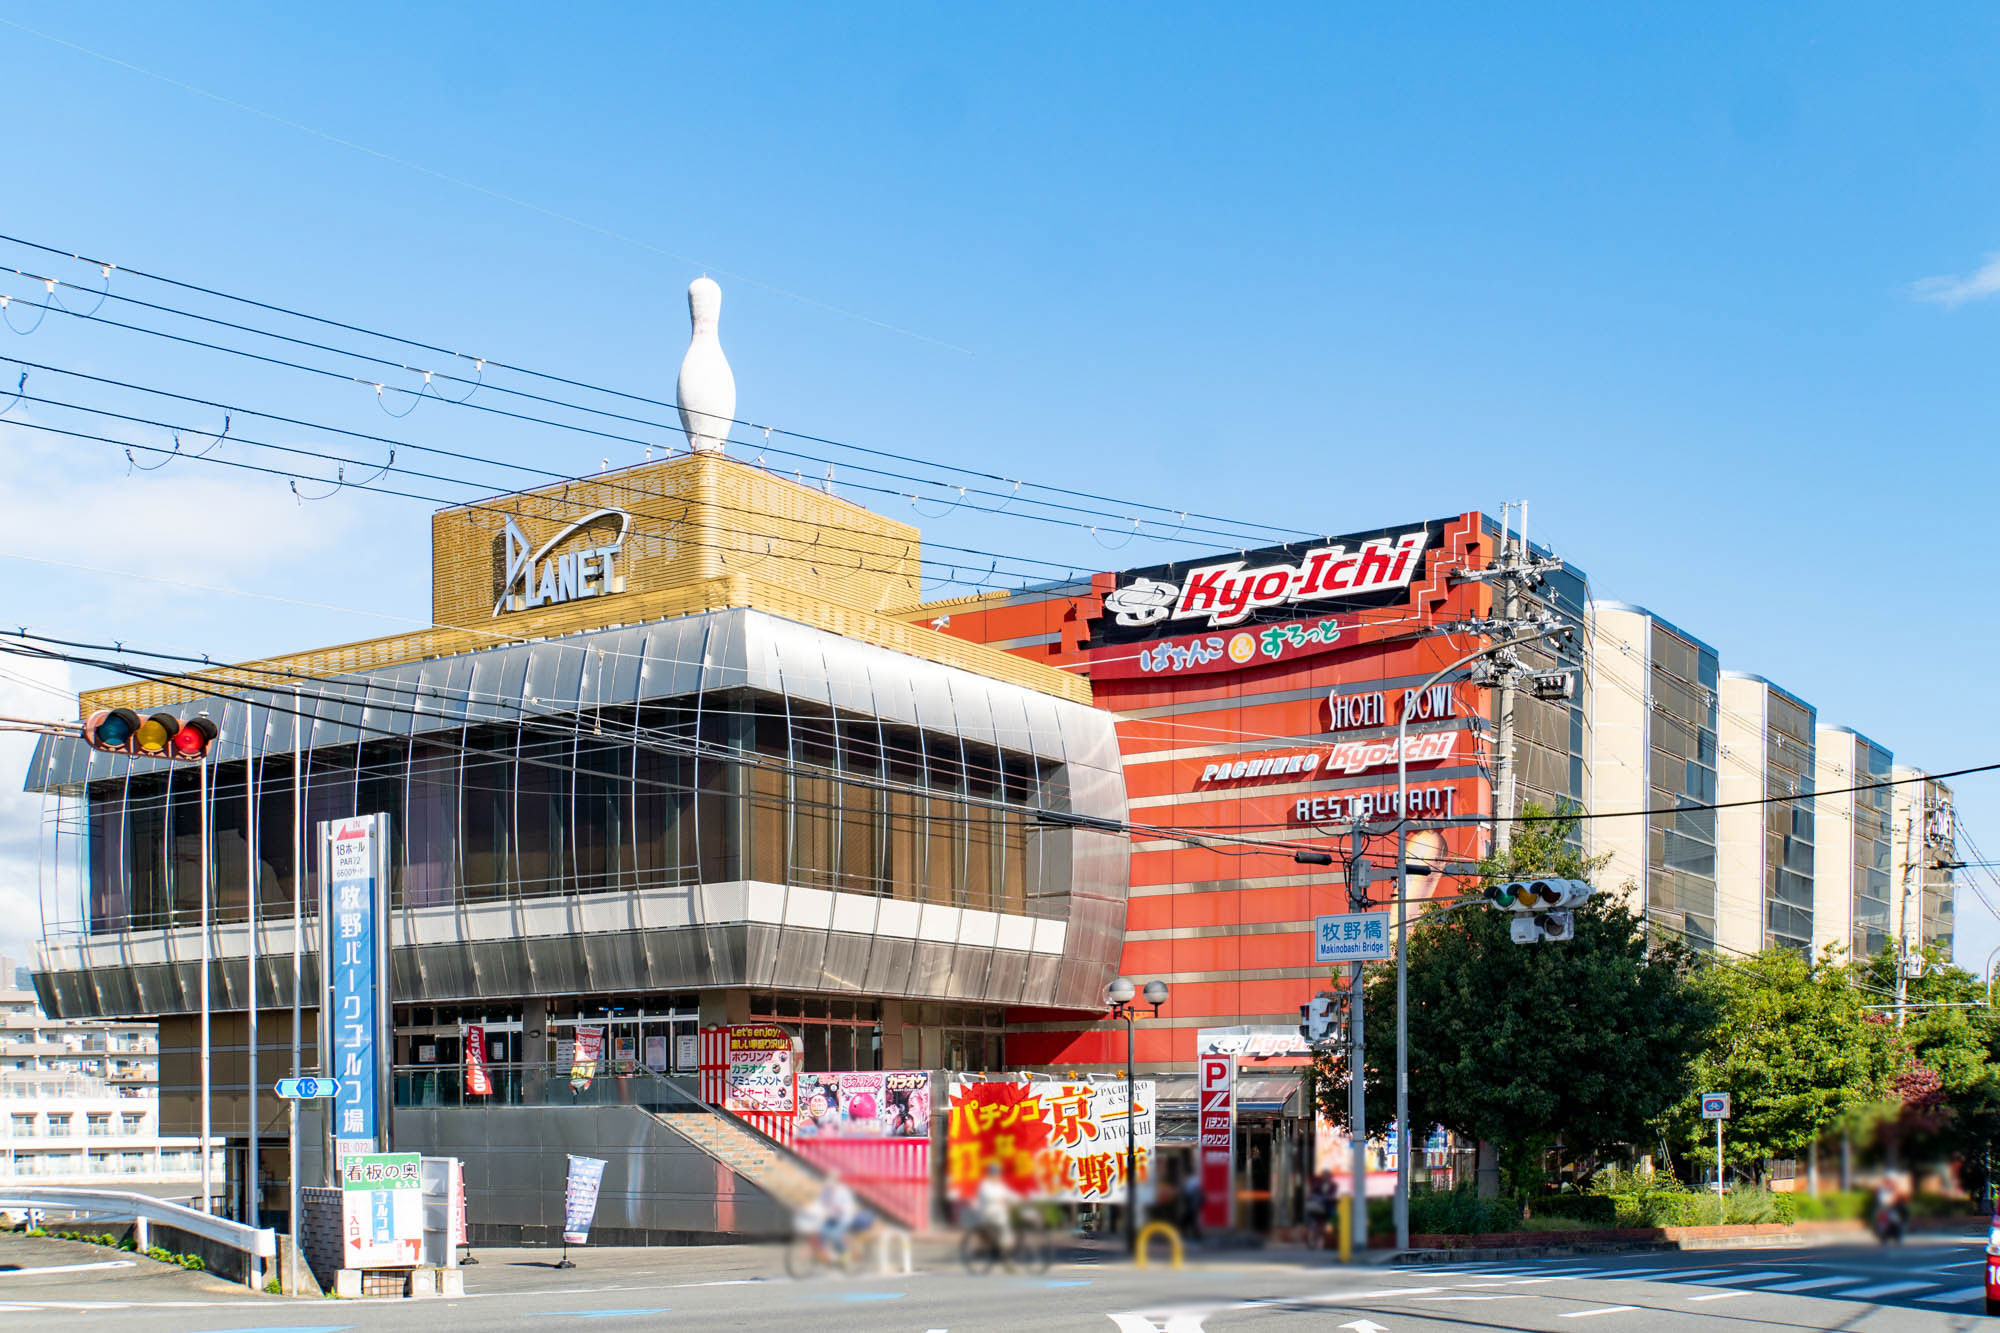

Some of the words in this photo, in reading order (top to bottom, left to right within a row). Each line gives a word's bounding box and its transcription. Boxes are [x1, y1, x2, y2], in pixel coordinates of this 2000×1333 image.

[498, 509, 630, 614] PLANET
[1177, 538, 1420, 620] Kyo-Ichi
[1140, 637, 1224, 672] ぱちんこ
[1261, 619, 1340, 658] すろっと
[1328, 689, 1385, 731] SHOEN
[1404, 684, 1456, 720] BOWL
[1201, 753, 1320, 782] PACHINKO
[336, 841, 366, 856] 18ホール
[1322, 920, 1383, 941] 牧野橋
[1321, 943, 1361, 954] Makinobashi
[1362, 941, 1384, 953] Bridge
[340, 885, 365, 1133] 牧野パークゴルフ場
[731, 1027, 753, 1038] Let's
[754, 1027, 781, 1038] enjoy!
[732, 1051, 774, 1063] ボウリング
[732, 1064, 767, 1074] カラオケ
[1206, 1062, 1227, 1088] P
[300, 1081, 316, 1095] 13
[732, 1076, 782, 1086] アミューズメント
[842, 1074, 882, 1088] ボウリング
[887, 1073, 927, 1089] カラオケ
[1100, 1081, 1148, 1097] PACHIKO
[761, 1100, 782, 1110] ダーツ
[1118, 1092, 1142, 1104] SLT
[950, 1099, 1040, 1138] パチンコ
[1045, 1085, 1148, 1148] 京一
[1205, 1117, 1229, 1129] パチンコ
[1103, 1120, 1152, 1141] KYO-CHI
[346, 1163, 418, 1182] 看板の奥
[349, 1215, 360, 1236] 入口
